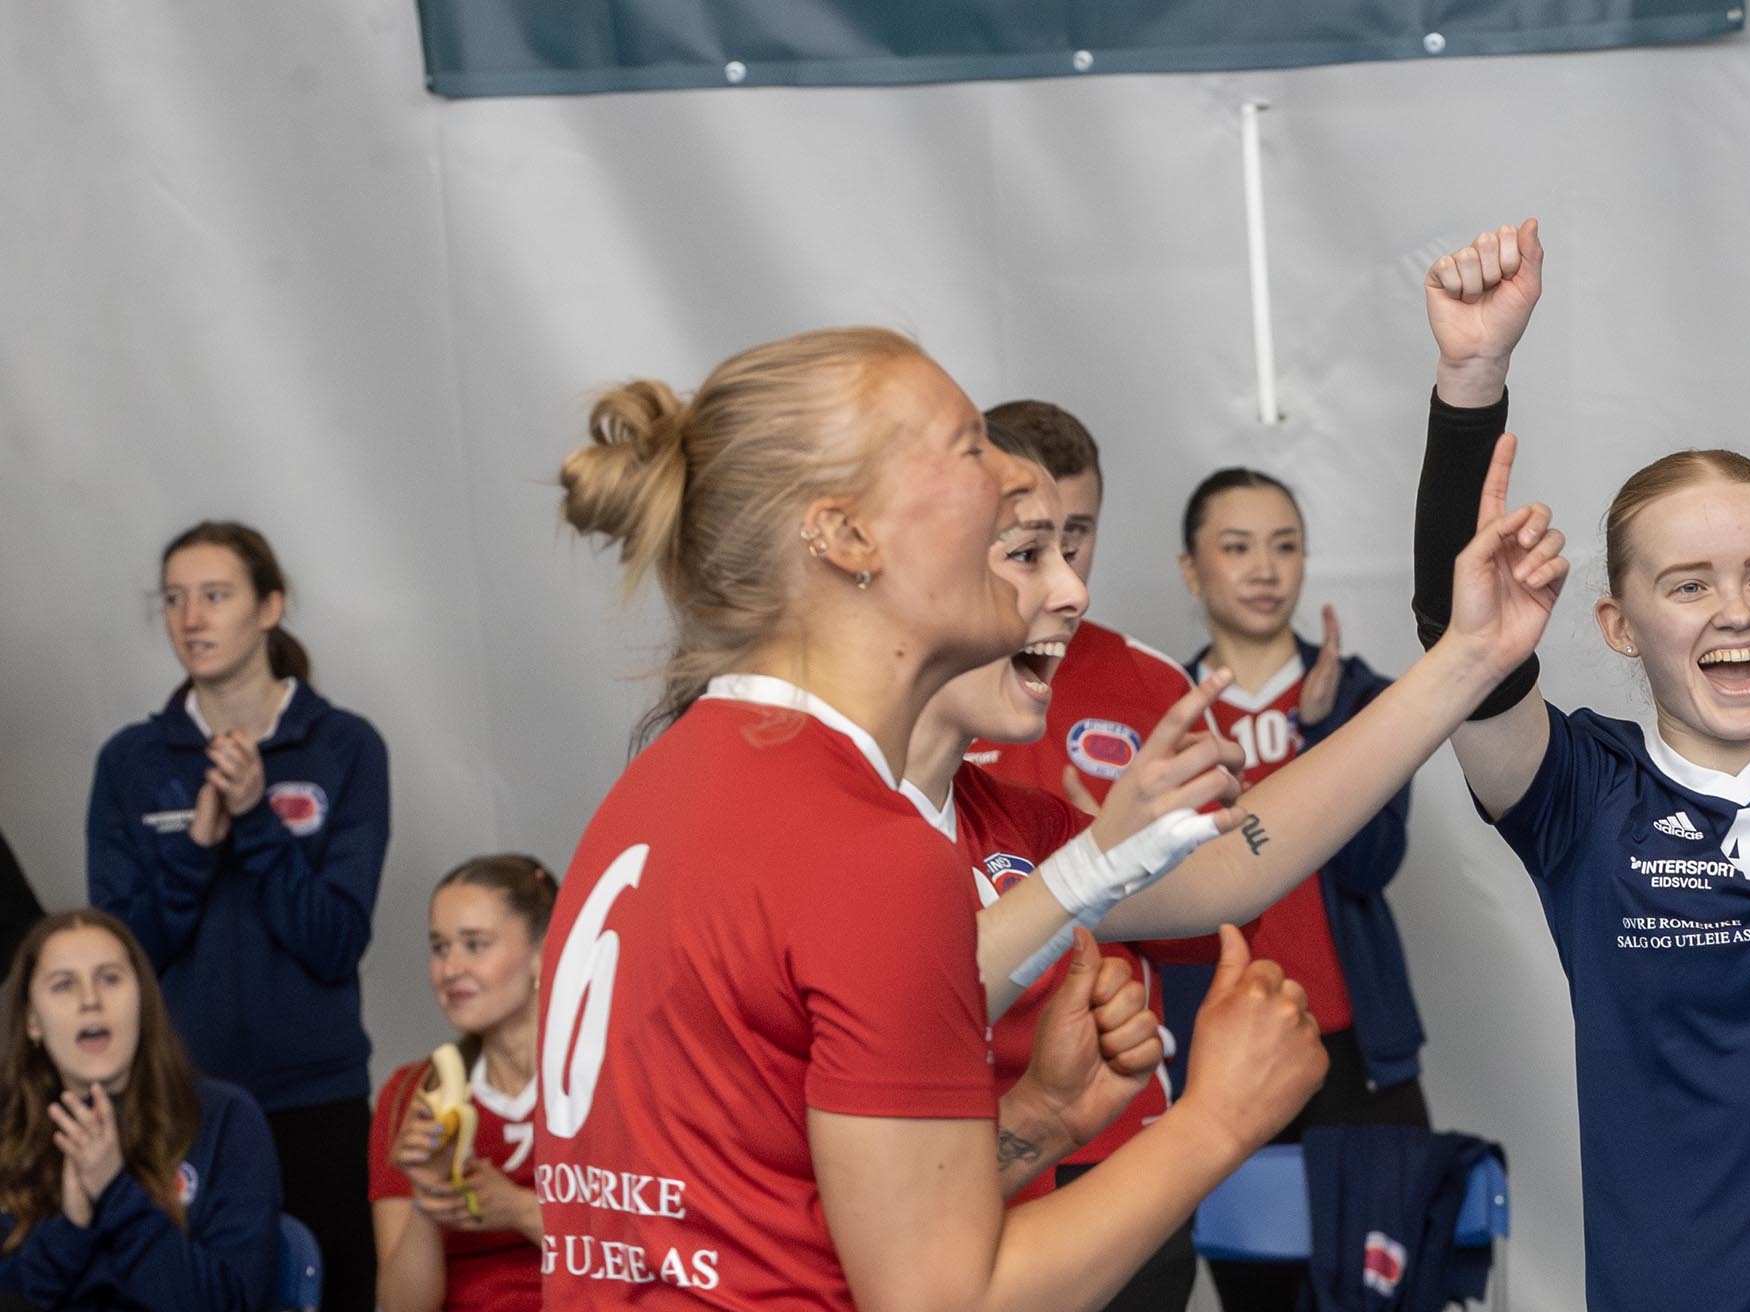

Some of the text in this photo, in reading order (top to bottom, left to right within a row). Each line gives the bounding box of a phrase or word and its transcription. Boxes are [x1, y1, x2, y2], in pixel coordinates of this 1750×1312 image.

[1230, 709, 1288, 768] 10
[1653, 820, 1704, 840] adidas
[1641, 859, 1736, 878] INTERSPORT
[1651, 876, 1712, 890] EIDSVOLL
[1622, 917, 1656, 930] ØVRE
[1617, 935, 1648, 949] SALG
[1650, 936, 1672, 949] OG
[1675, 931, 1730, 947] UTLEIE
[542, 843, 650, 1139] 6
[502, 1122, 534, 1173] 7
[660, 1247, 719, 1290] AS
